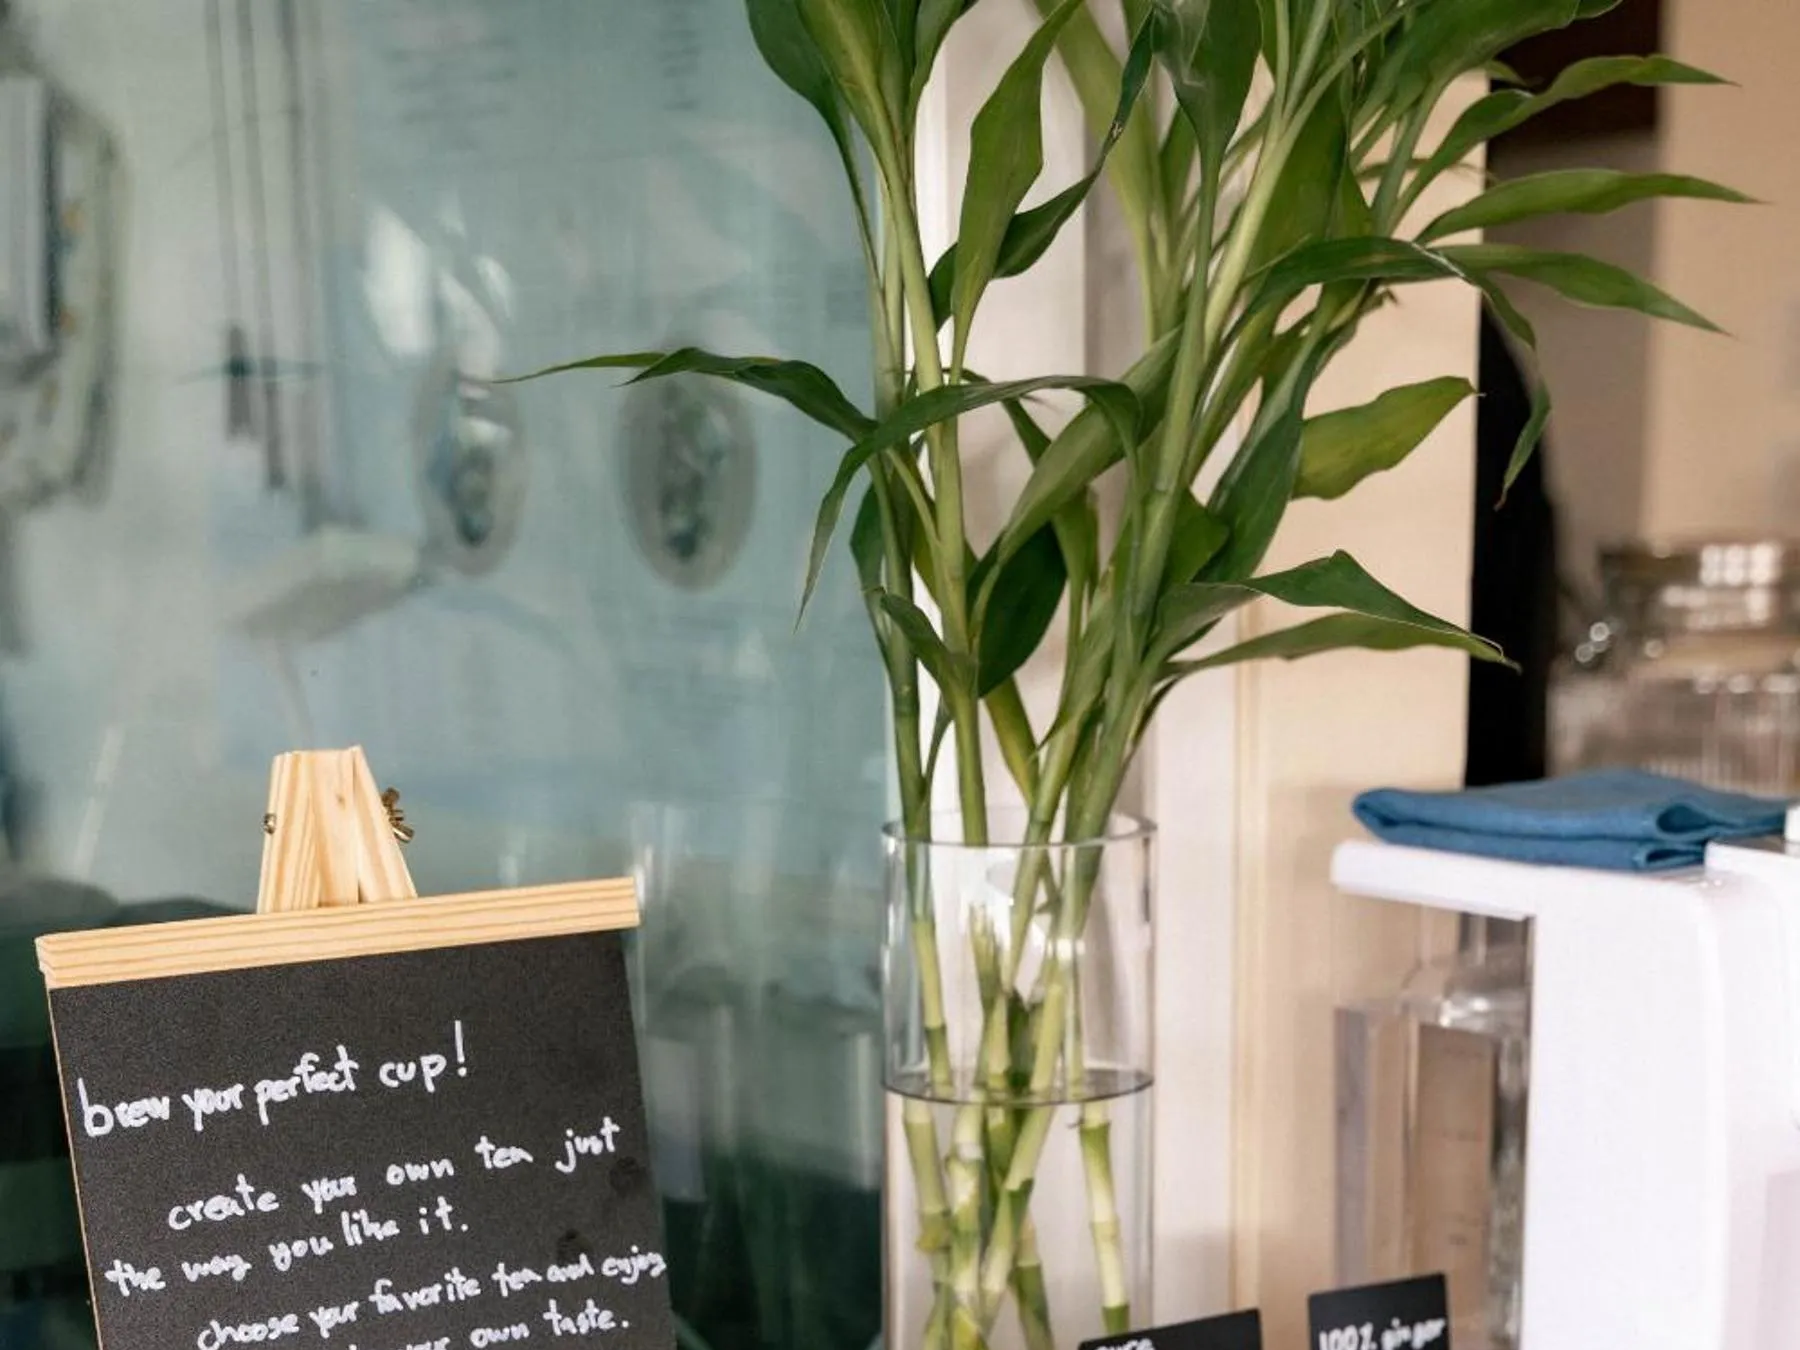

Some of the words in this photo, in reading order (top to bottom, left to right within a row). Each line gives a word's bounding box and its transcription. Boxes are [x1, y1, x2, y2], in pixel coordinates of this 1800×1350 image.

[77, 1077, 171, 1138] brew
[181, 1083, 245, 1133] your
[253, 1044, 360, 1126] perfect
[167, 1172, 280, 1231] create
[300, 1175, 360, 1219] your
[385, 1158, 455, 1186] own
[474, 1135, 534, 1170] tea
[554, 1116, 621, 1174] just
[103, 1258, 167, 1298] the
[267, 1235, 335, 1272] you
[340, 1208, 401, 1247] like
[418, 1195, 469, 1235] it.
[308, 1300, 360, 1340] your
[368, 1266, 482, 1315] favorite
[491, 1262, 543, 1298] tea
[546, 1253, 595, 1283] and
[469, 1322, 530, 1349] own
[542, 1298, 630, 1337] taste.
